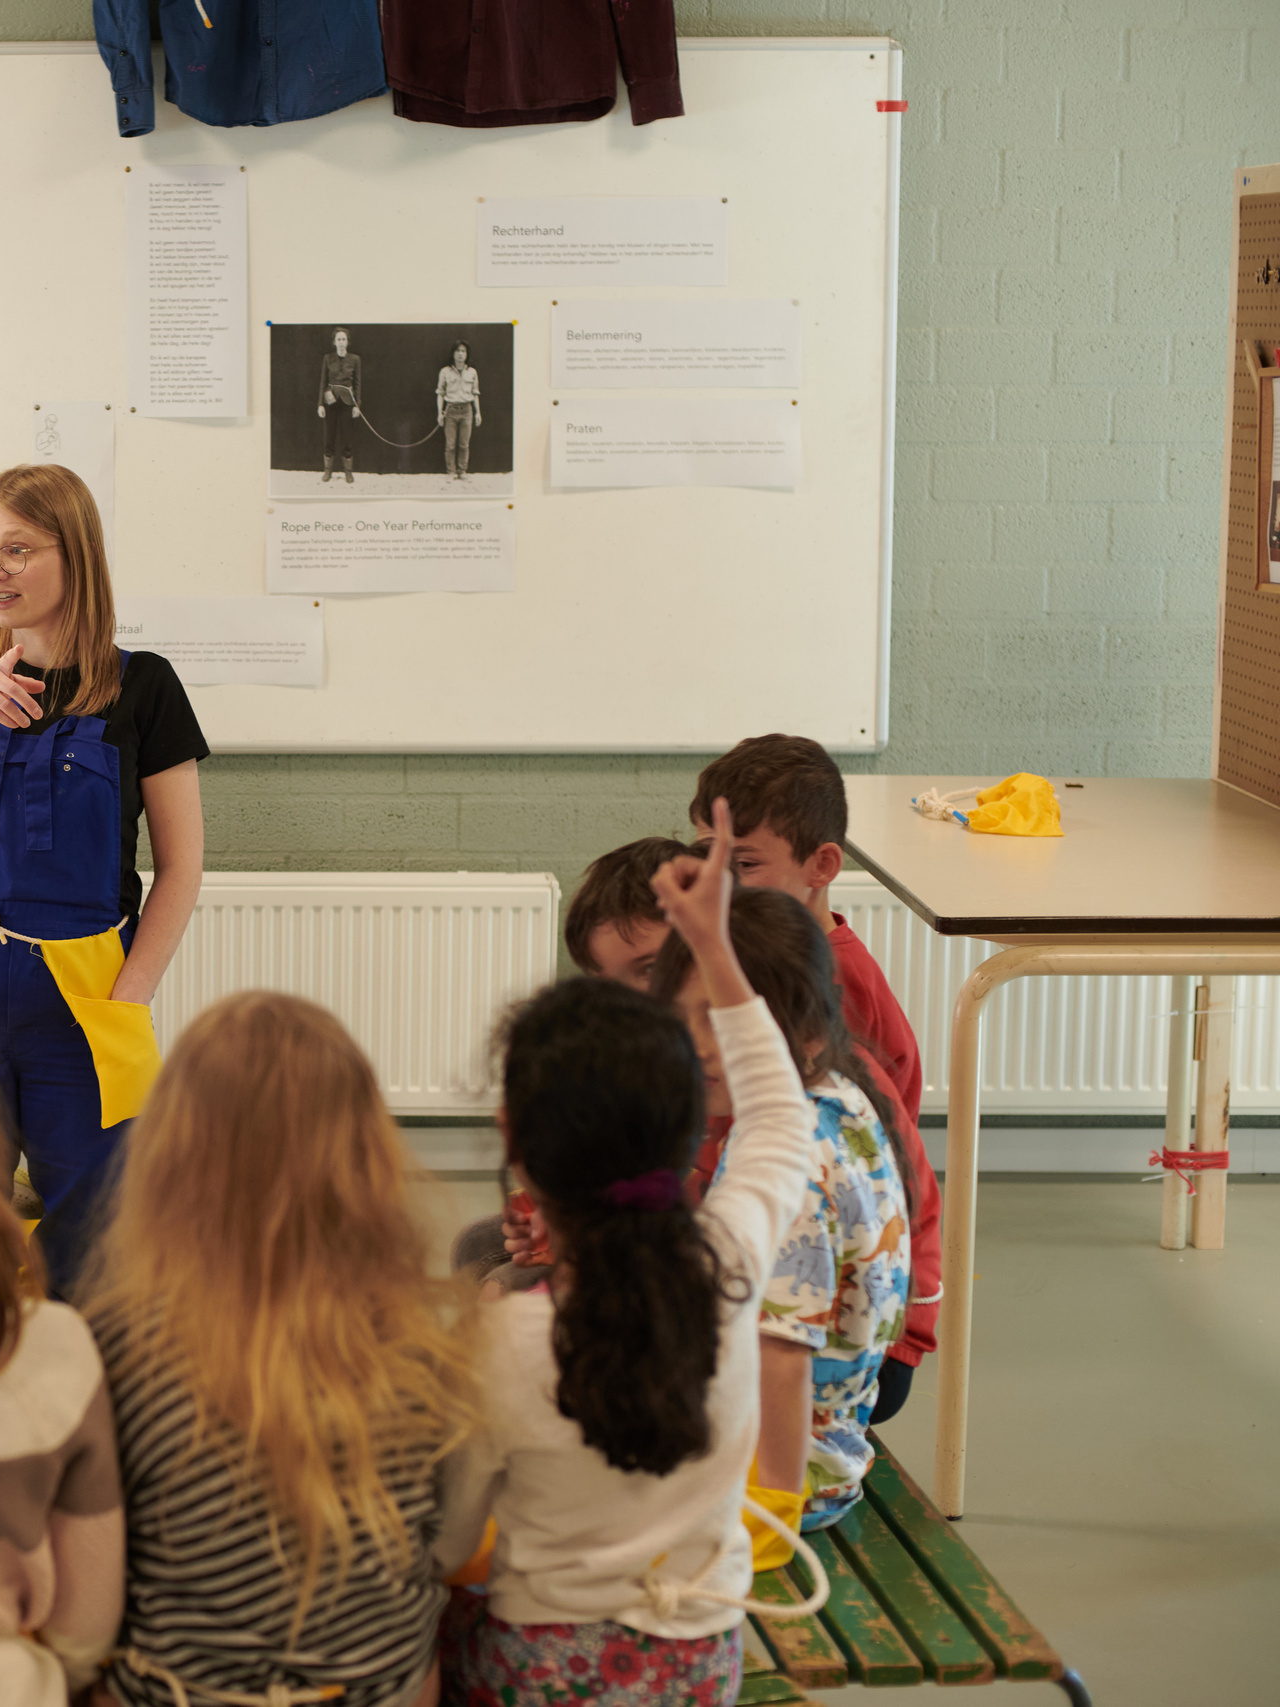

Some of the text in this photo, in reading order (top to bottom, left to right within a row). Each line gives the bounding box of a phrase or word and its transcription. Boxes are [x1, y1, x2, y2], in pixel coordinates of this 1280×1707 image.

[492, 224, 565, 236] Rechterhand
[566, 329, 643, 343] Belemmering
[566, 422, 603, 434] Praten
[281, 521, 311, 535] Rope
[314, 521, 345, 532] Piece
[355, 520, 380, 531] One
[383, 520, 409, 531] Year
[412, 519, 482, 531] Performance
[116, 623, 143, 634] dtaal
